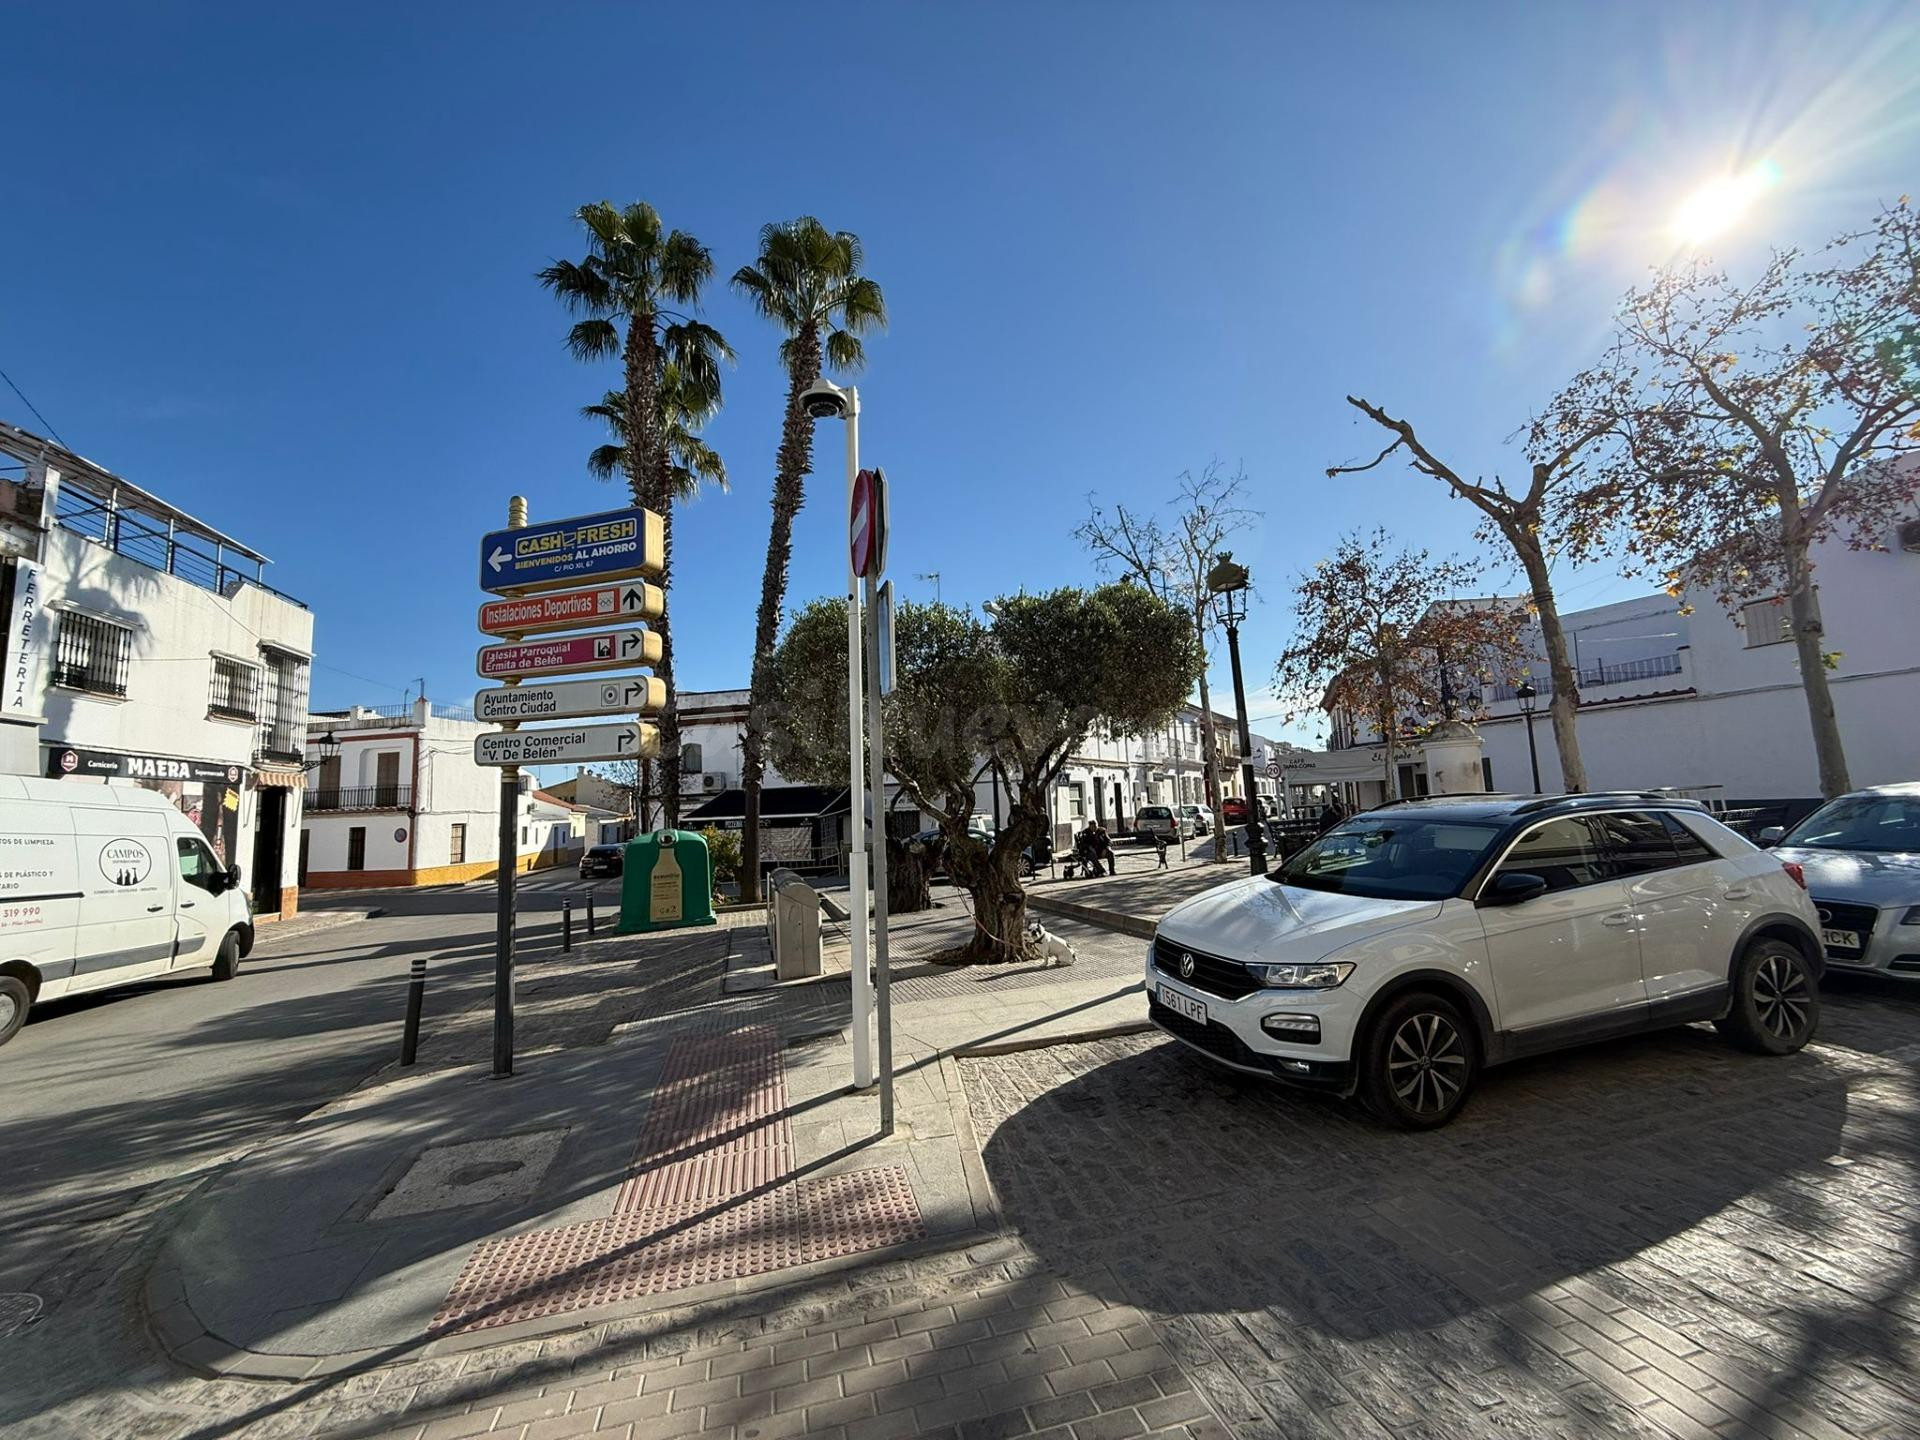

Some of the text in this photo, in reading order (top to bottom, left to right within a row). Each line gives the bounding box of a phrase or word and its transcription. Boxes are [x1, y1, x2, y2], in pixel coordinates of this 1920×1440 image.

[518, 521, 634, 554] CASH FRESH
[515, 542, 637, 570] BIENVENIDOS AL AHORRO
[486, 595, 592, 624] Instalaciones Deportivas
[13, 568, 37, 708] FERRETERIA
[486, 643, 571, 663] Iglesia Parroquial
[485, 653, 563, 672] Ermita de Belén
[484, 689, 554, 706] Ayuntamiento
[484, 701, 556, 716] Centro Ciudad
[482, 732, 586, 750] Centro Comercial
[502, 749, 519, 761] De
[127, 757, 191, 779] MAERA
[1268, 767, 1279, 775] 20
[24, 838, 54, 846] LIMPIEZA
[107, 848, 144, 859] CAMPOS
[22, 906, 41, 916] 990
[1162, 988, 1203, 1020] 1561 LPF
